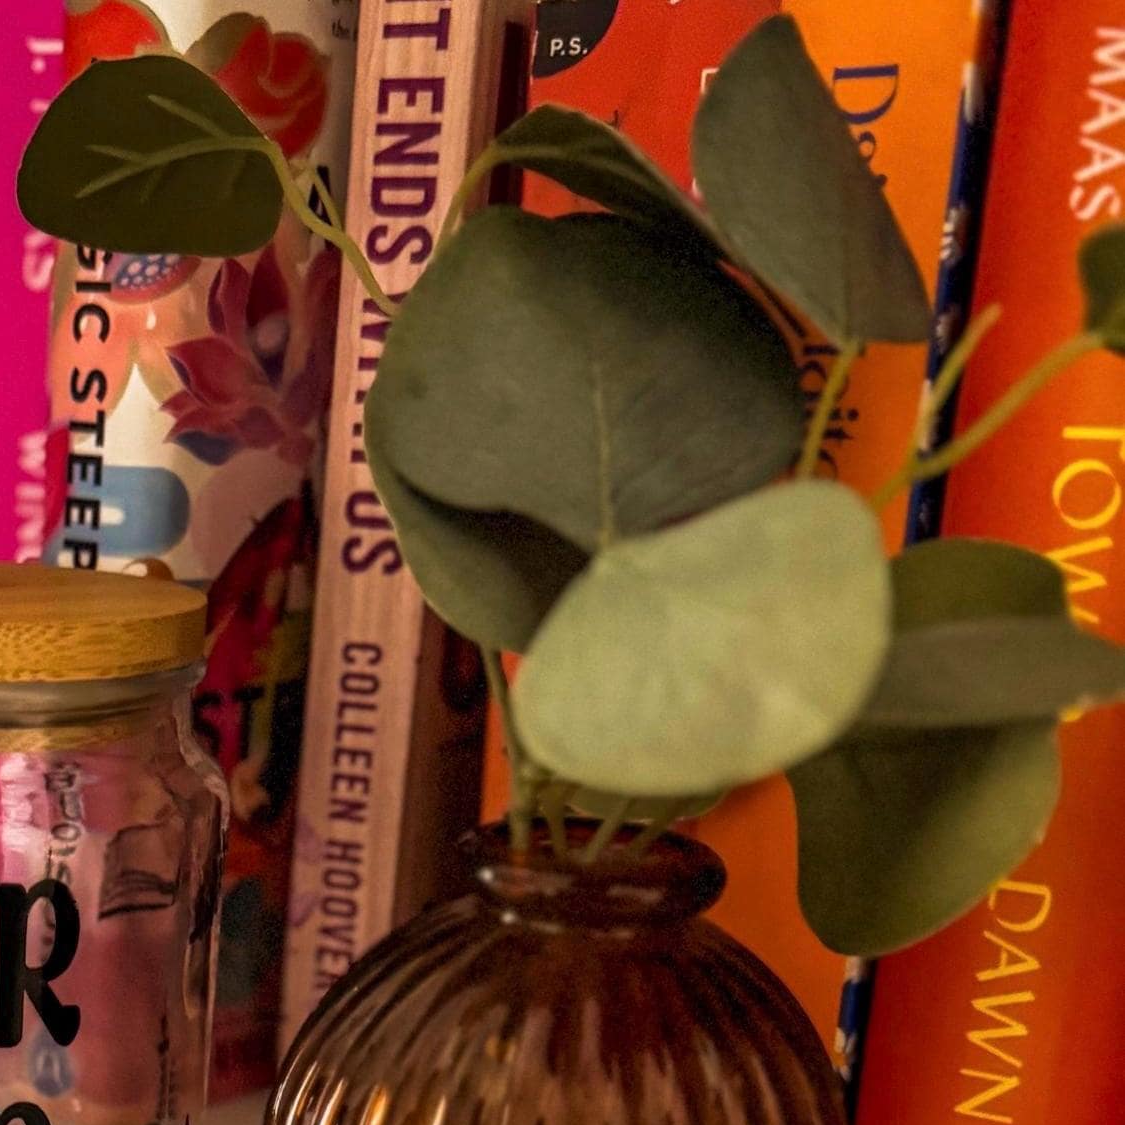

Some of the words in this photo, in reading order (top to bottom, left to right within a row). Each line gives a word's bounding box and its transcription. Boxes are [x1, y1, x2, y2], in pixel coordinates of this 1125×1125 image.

[383, 0, 452, 50] T
[549, 37, 589, 57] P.S.
[365, 77, 446, 265] ENDS
[1070, 27, 1125, 220] MAAS
[62, 367, 108, 571] STEEP
[341, 490, 403, 577] US
[327, 641, 383, 825] COLLEEN
[954, 878, 1053, 1125] DAWN
